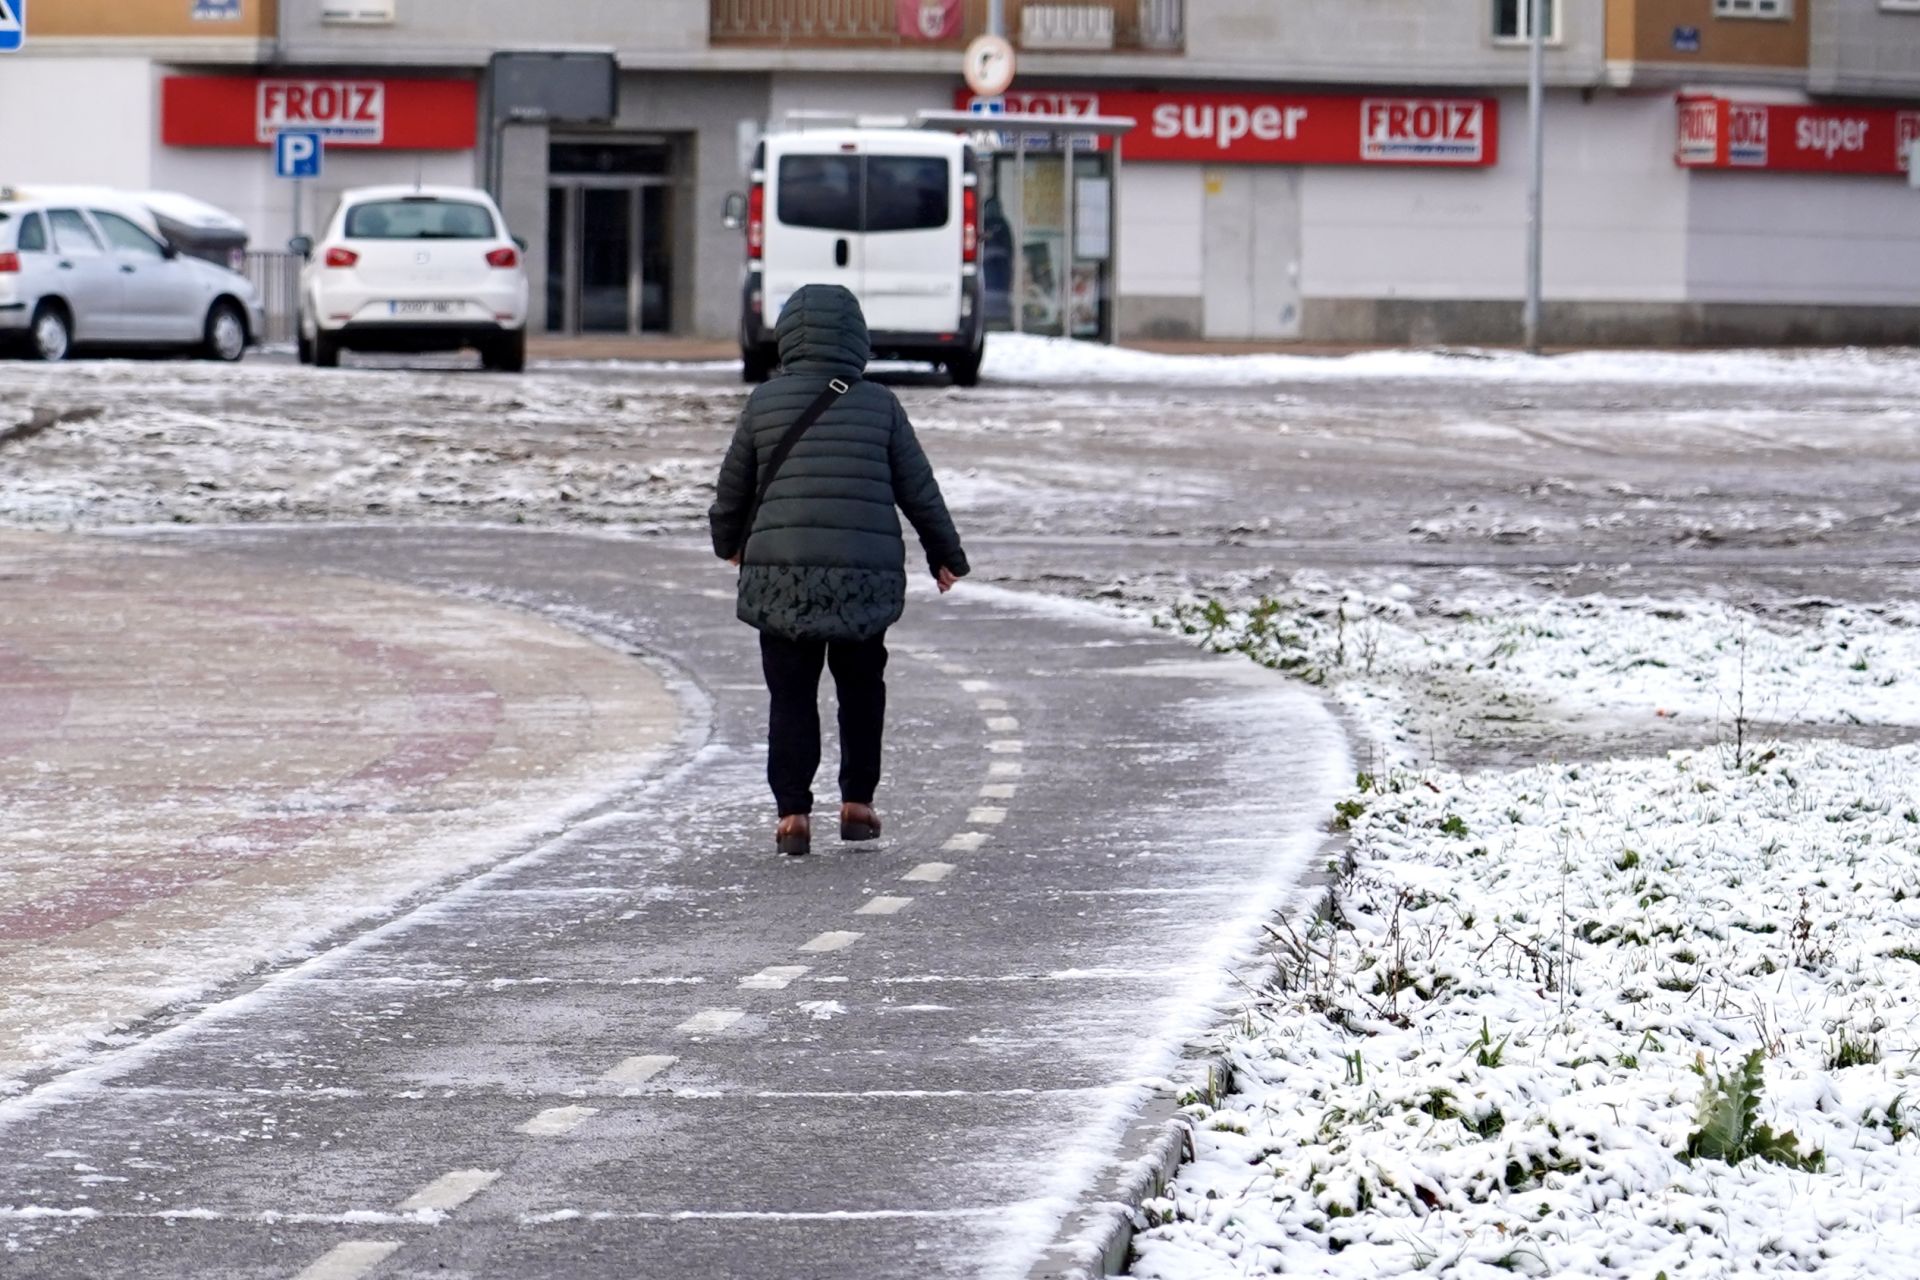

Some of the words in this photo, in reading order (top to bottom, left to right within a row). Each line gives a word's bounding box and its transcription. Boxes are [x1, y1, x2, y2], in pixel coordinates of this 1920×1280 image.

[264, 86, 377, 121] FROIZ
[1152, 102, 1307, 148] super
[1368, 105, 1475, 139] FROIZ
[1795, 116, 1869, 158] super
[282, 135, 314, 174] P
